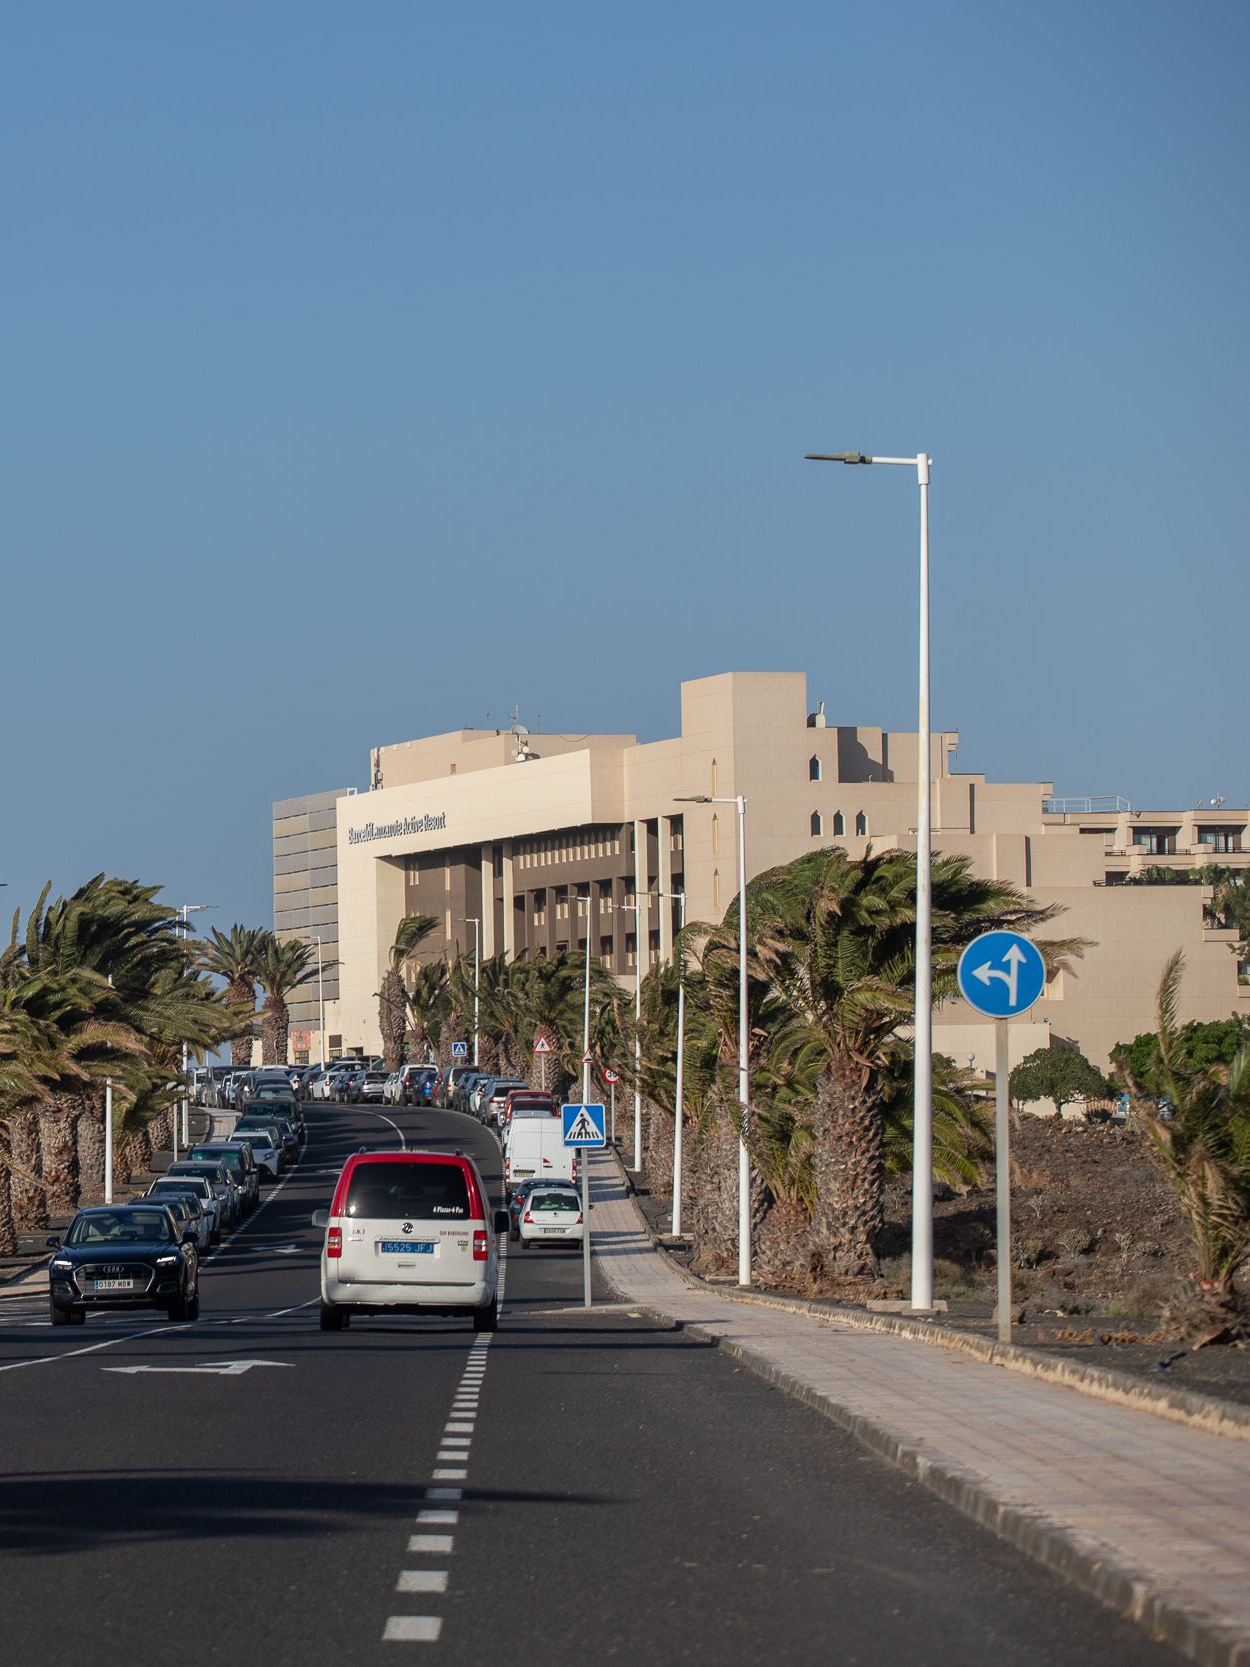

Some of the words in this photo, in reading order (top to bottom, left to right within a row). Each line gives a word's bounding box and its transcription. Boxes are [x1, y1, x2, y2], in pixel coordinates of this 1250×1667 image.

[403, 816, 424, 836] Active
[424, 812, 446, 832] Resort
[387, 1242, 412, 1252] 5525
[414, 1243, 433, 1253] JFJ
[98, 1280, 116, 1288] 0187
